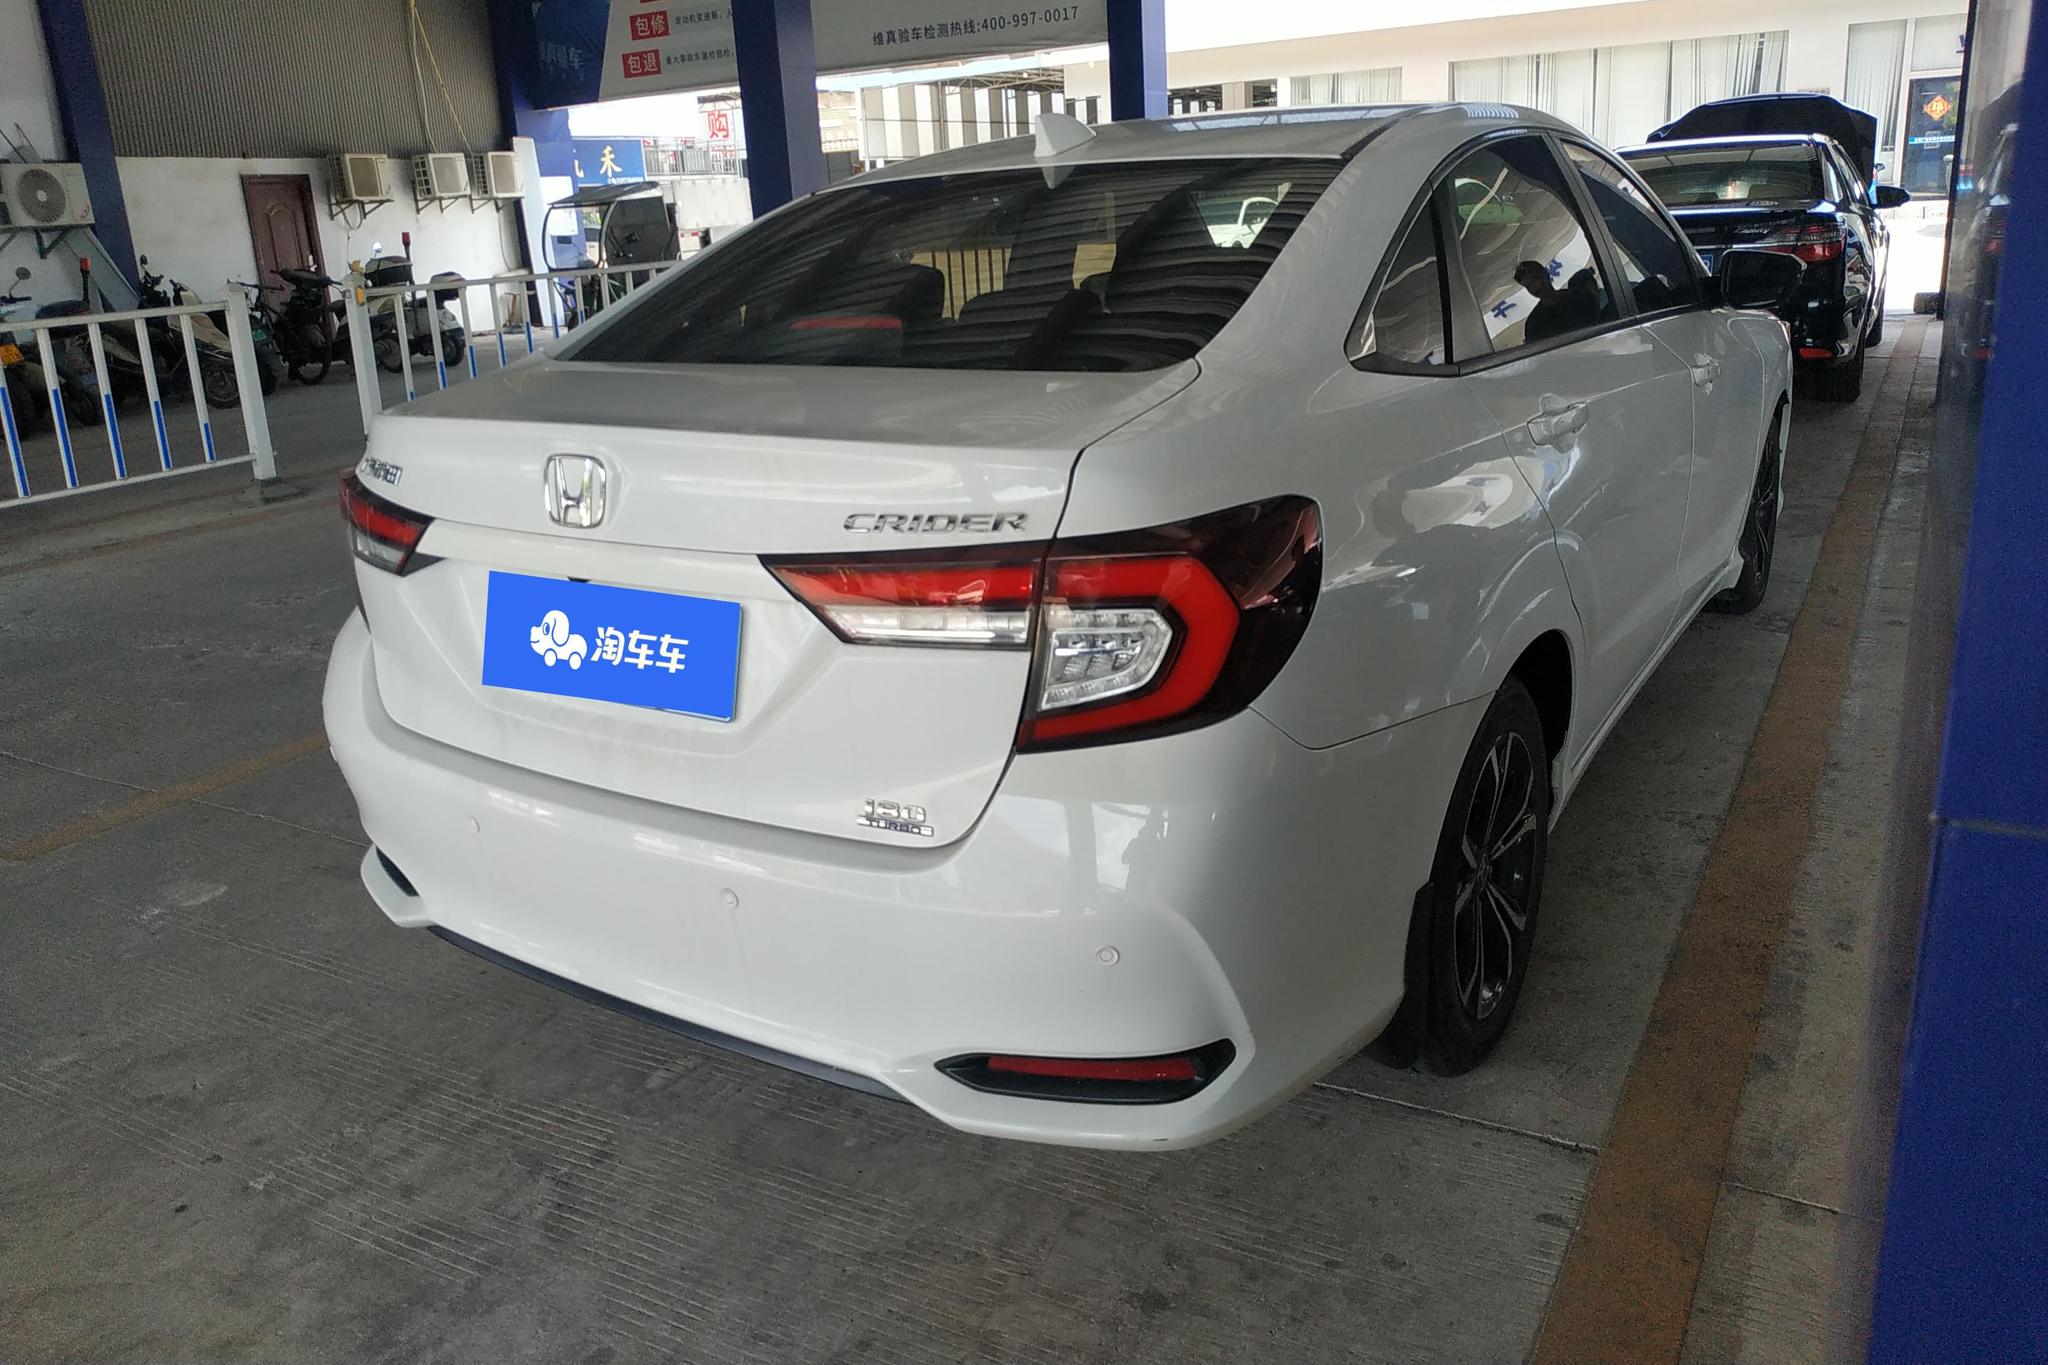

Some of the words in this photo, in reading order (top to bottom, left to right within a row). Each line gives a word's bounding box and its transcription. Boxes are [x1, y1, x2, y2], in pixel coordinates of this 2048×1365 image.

[636, 13, 666, 36] 包修
[873, 6, 1079, 45] 维真验车检测热线:400-997-0017
[628, 52, 658, 74] 包退
[707, 110, 730, 139] 购
[843, 512, 1028, 533] CRIDER
